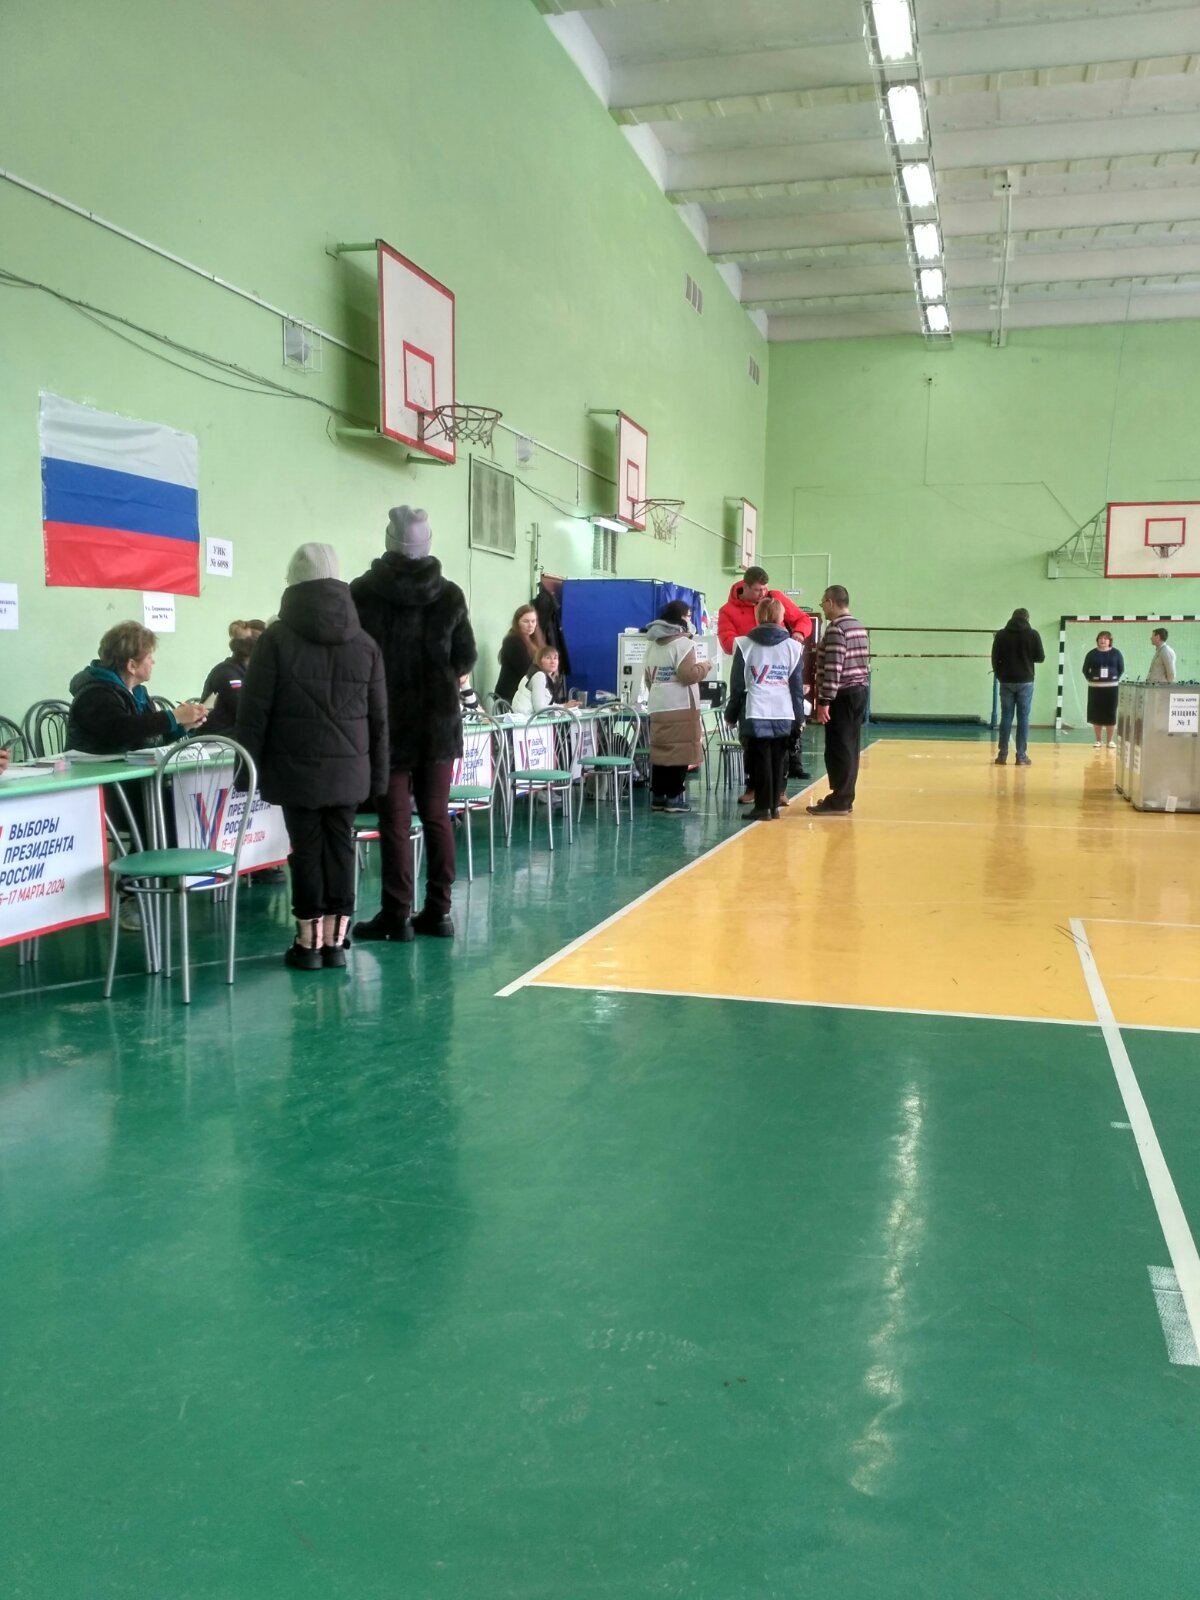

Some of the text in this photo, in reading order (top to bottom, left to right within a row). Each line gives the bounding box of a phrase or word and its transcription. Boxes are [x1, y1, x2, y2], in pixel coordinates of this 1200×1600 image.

[1171, 710, 1198, 718] ЯЩИК
[228, 799, 271, 817] ПРЕЗДЕНТА
[9, 817, 60, 841] ВЫБОРЫ
[224, 817, 253, 836] РОСИ
[3, 835, 75, 864] ПРЕЗИДЕНТА
[0, 862, 45, 886] РОССИИ
[17, 883, 45, 903] МАРТА
[46, 878, 65, 895] 2024
